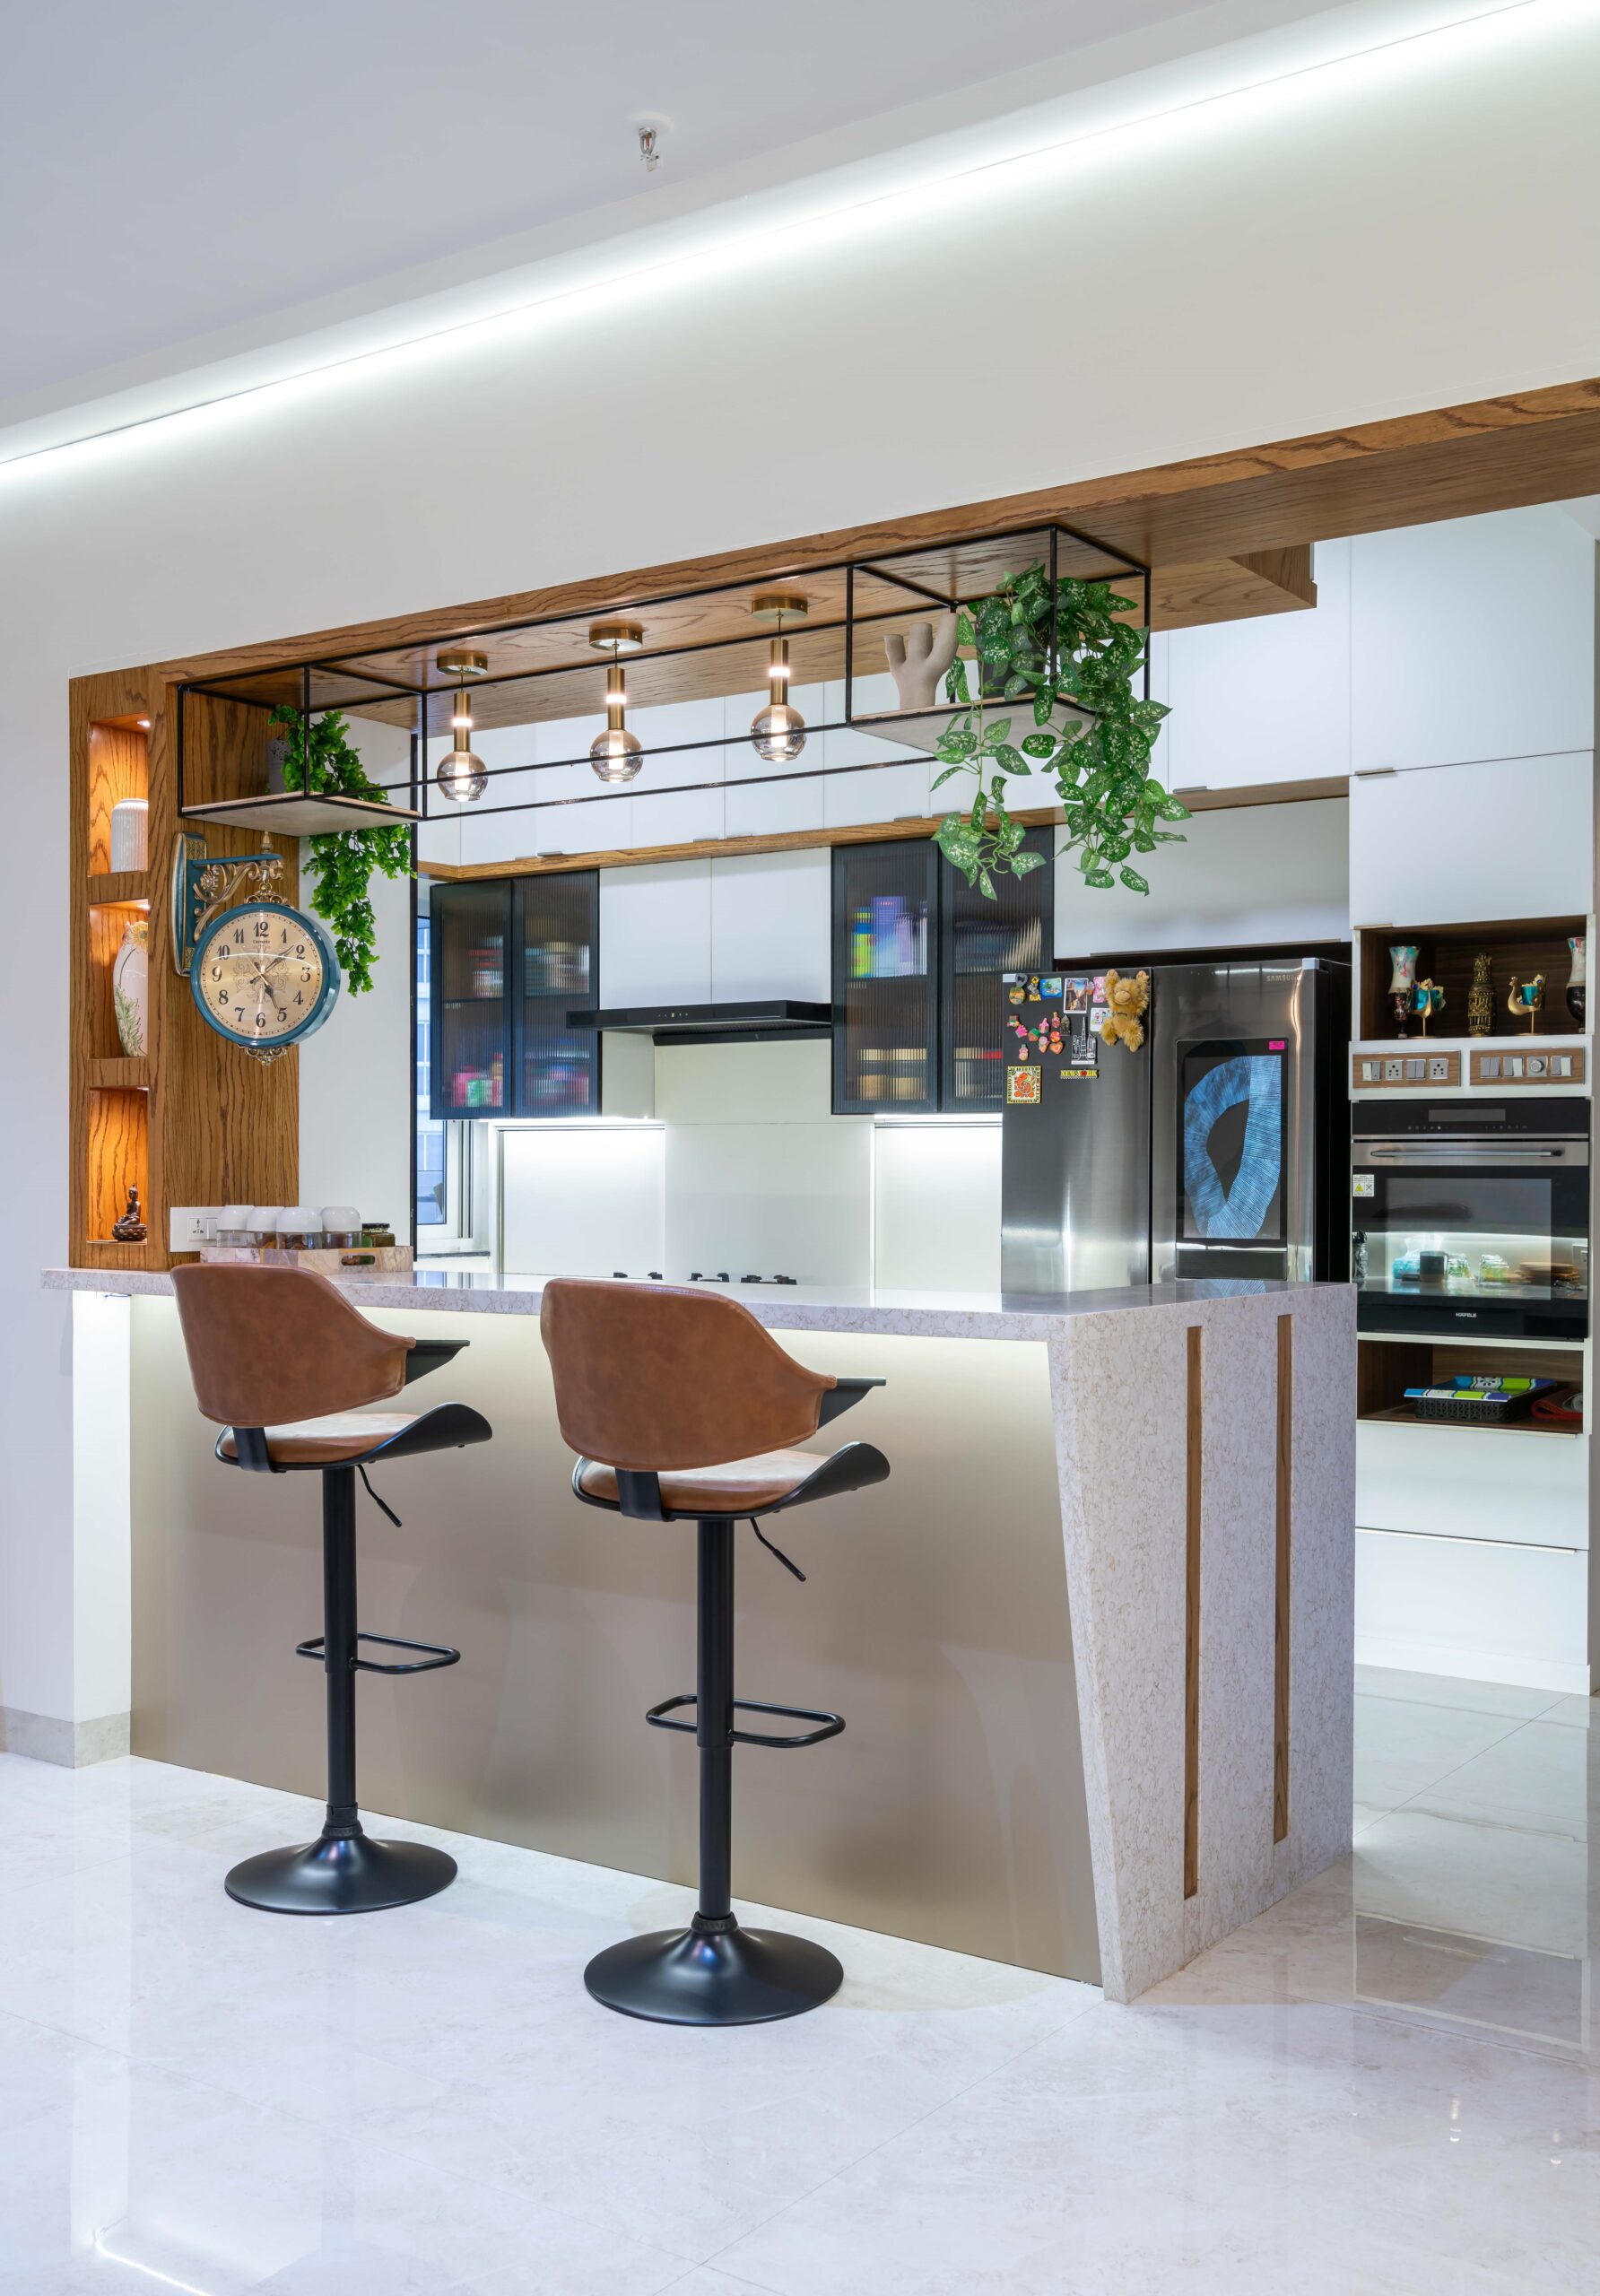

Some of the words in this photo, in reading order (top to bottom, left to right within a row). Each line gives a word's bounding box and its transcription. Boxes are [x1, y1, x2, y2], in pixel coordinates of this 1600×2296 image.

[233, 928, 245, 944] 11
[253, 921, 269, 937] 12
[281, 928, 287, 944] 1
[218, 944, 230, 961] 10
[296, 944, 305, 960] 2
[212, 967, 222, 982] 9
[300, 967, 311, 982] 3
[218, 990, 229, 1004] 8
[293, 990, 304, 1005] 4
[234, 1007, 245, 1022] 7
[256, 1012, 266, 1028] 6
[277, 1007, 287, 1022] 5
[1060, 1069, 1075, 1077] NEW
